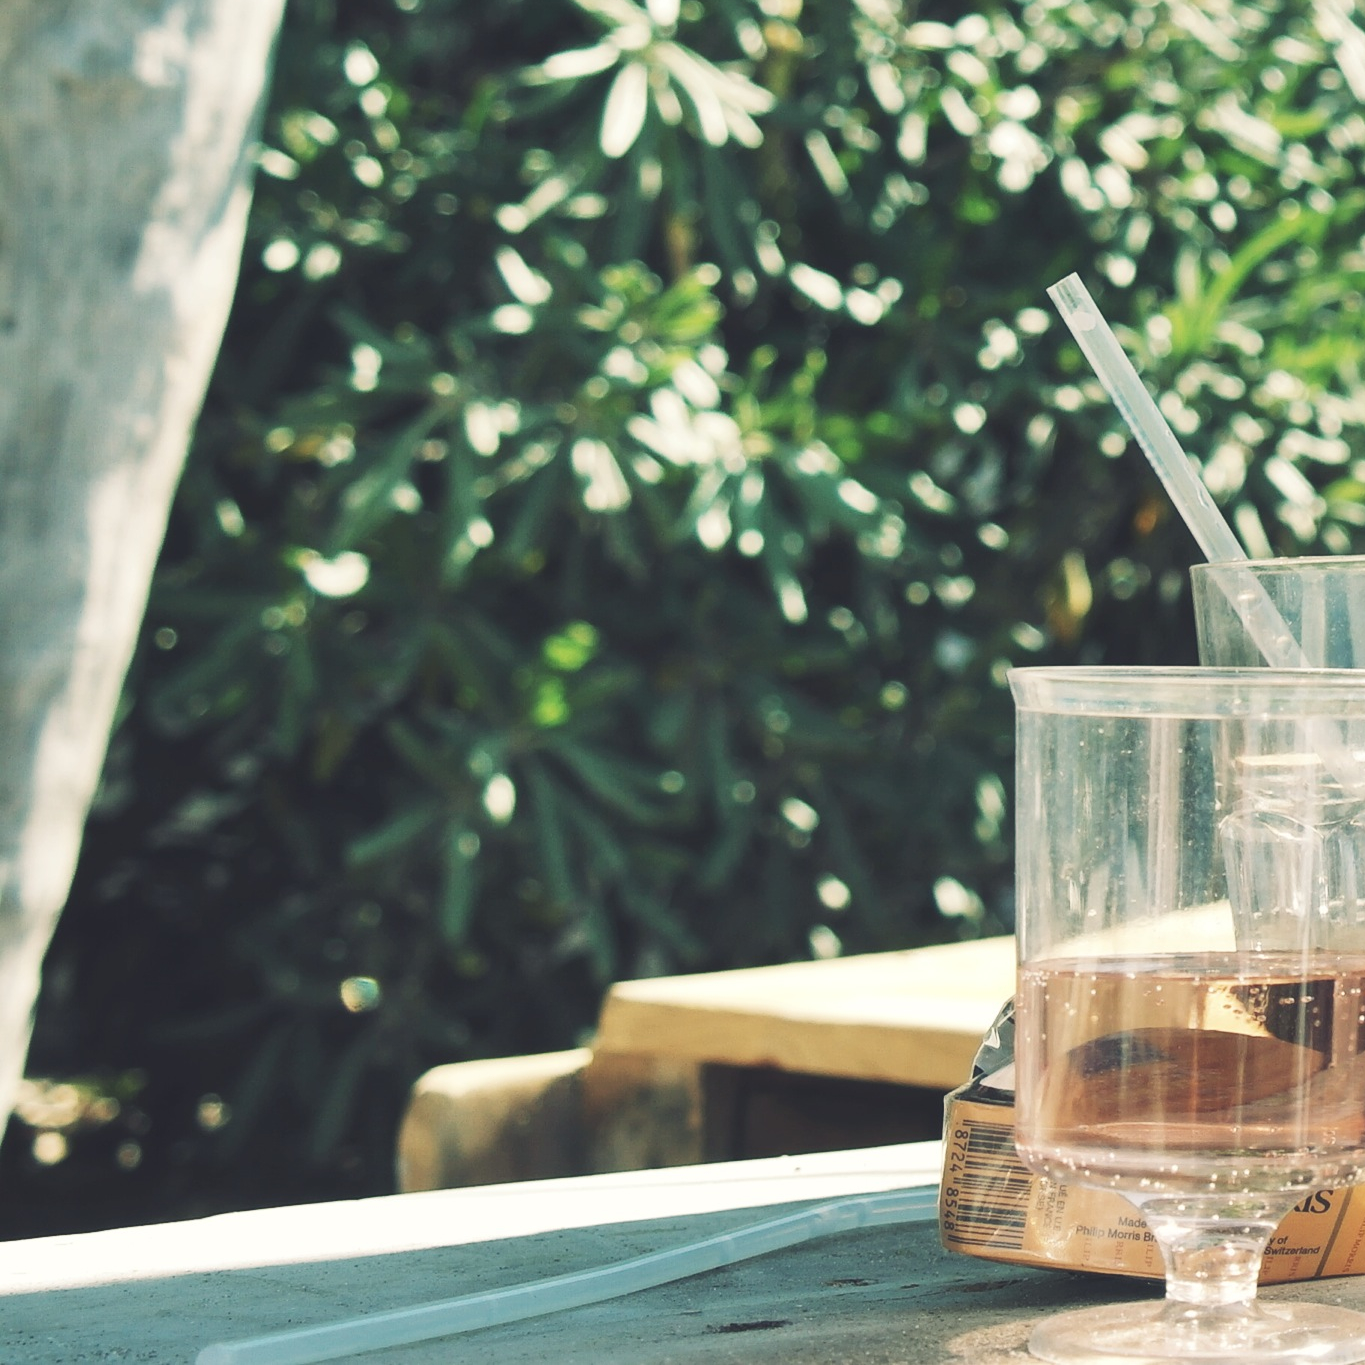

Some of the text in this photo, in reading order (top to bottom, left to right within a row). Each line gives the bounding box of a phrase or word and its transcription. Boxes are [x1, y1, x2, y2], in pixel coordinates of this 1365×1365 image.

[943, 1129, 969, 1232] 8724 8548
[1118, 1217, 1147, 1229] Made
[1075, 1225, 1105, 1239] Philip
[1107, 1228, 1141, 1241] Morris
[1277, 1236, 1289, 1245] of
[1264, 1245, 1321, 1255] Switzerland
